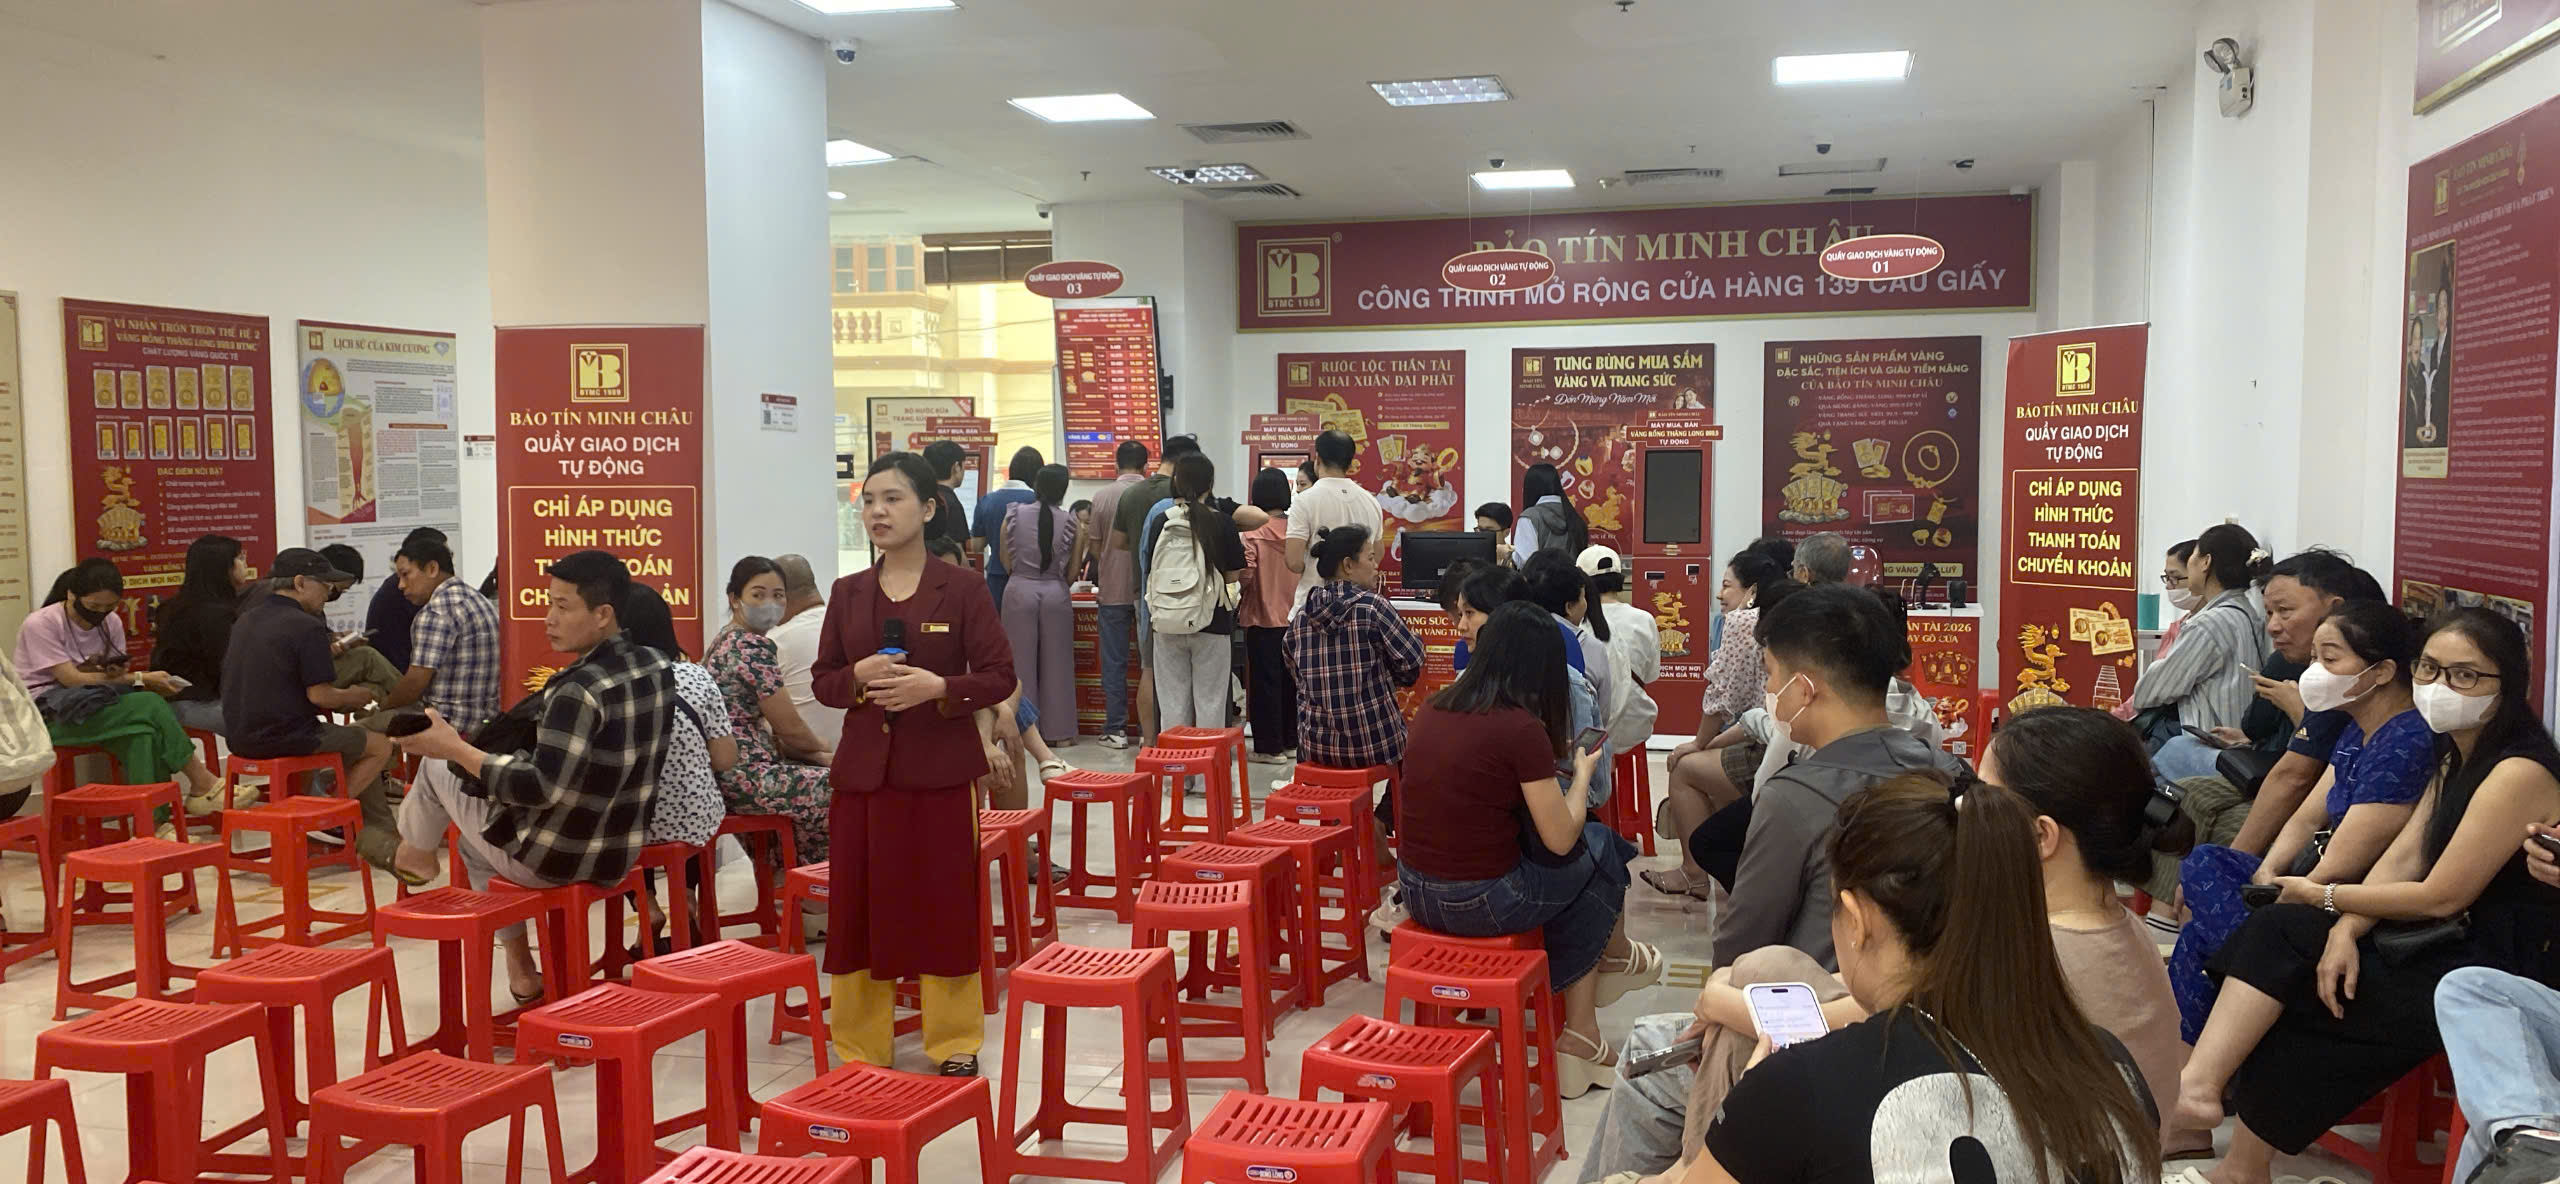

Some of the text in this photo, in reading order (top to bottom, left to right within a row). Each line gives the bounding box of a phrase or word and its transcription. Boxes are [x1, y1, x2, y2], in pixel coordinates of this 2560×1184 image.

[1557, 228, 1626, 264] TÍN
[1635, 230, 1749, 261] MINH
[1847, 252, 1864, 260] GIAO
[1865, 250, 1882, 260] DỊCH
[1884, 248, 1904, 257] VÀNG
[1904, 248, 1915, 259] TỰ
[1916, 246, 1938, 257] ĐỘNG
[1467, 264, 1483, 272] GIAO
[1484, 263, 1499, 273] DỊCH
[1500, 262, 1518, 271] VÀNG
[1519, 262, 1528, 272] TỰ
[1529, 261, 1549, 272] ĐỘNG
[1872, 261, 1889, 273] 01
[1061, 273, 1076, 283] DỊCH
[1076, 272, 1092, 281] VÀNG
[1102, 271, 1120, 282] ĐỘNG
[1358, 284, 1430, 310] CÔNG
[1525, 275, 1566, 305] MỞ
[1573, 277, 1650, 307] RỘNG
[1660, 271, 1717, 300] CỬA
[1725, 272, 1804, 297] HÀNG
[1815, 275, 1859, 296] 139
[1937, 260, 2006, 292] GIẤY
[1490, 274, 1506, 286] 02
[1067, 283, 1082, 294] 03
[1268, 298, 1321, 309] BTMC 1989
[1554, 349, 1702, 371] TƯNG BỪNG MUA SẮM
[1800, 349, 1945, 364] NHỮNG SẢN PHẨM VÀNG
[1321, 360, 1358, 373] RƯỚC
[1361, 359, 1386, 373] LỘC
[1430, 358, 1451, 371] TÀI
[1776, 367, 1799, 379] ĐẶC
[1850, 364, 1868, 376] ÍCH
[1869, 365, 1884, 375] VÀ
[1885, 363, 1911, 374] GIÀU
[1939, 362, 1969, 373] NĂNG
[1318, 373, 1455, 388] KHAI XUÂN ĐẠI PHÁT
[1554, 371, 1676, 388] VÀNG VÀ TRANG SỨC
[1827, 376, 1851, 390] BẢO
[1855, 377, 1873, 389] TÍN
[1875, 378, 1907, 388] MINH
[1910, 376, 1943, 388] CHÂU
[579, 388, 601, 396] BTMC
[510, 406, 693, 426] BẢO TÍN MINH CHÂU
[2016, 397, 2139, 419] BẢO TÍN MINH CHÂU
[1631, 430, 1647, 438] VÀNG
[2025, 421, 2129, 442] QUẦY GIAO DỊCH
[524, 430, 680, 456] QUẦY GIAO DỊCH
[2046, 443, 2103, 463] TỰ ĐỘNG
[558, 456, 644, 479] TỰ ĐỘNG
[2029, 476, 2122, 500] CHỈ ÁP DỤNG
[533, 494, 673, 521] CHỈ ÁP DỤNG
[2035, 502, 2113, 523] HÌNH THỨC
[545, 523, 662, 547] HÌNH THỨC
[2028, 529, 2120, 550] THANH TOÁN
[624, 554, 672, 576] OÁN
[1896, 565, 1918, 574] VÀNG
[2018, 552, 2132, 577] CHUYỂN KHOẢN
[1429, 616, 1449, 625] SỨC
[1922, 621, 1972, 632] TÀI 2026
[1424, 627, 1447, 636] VÀNG
